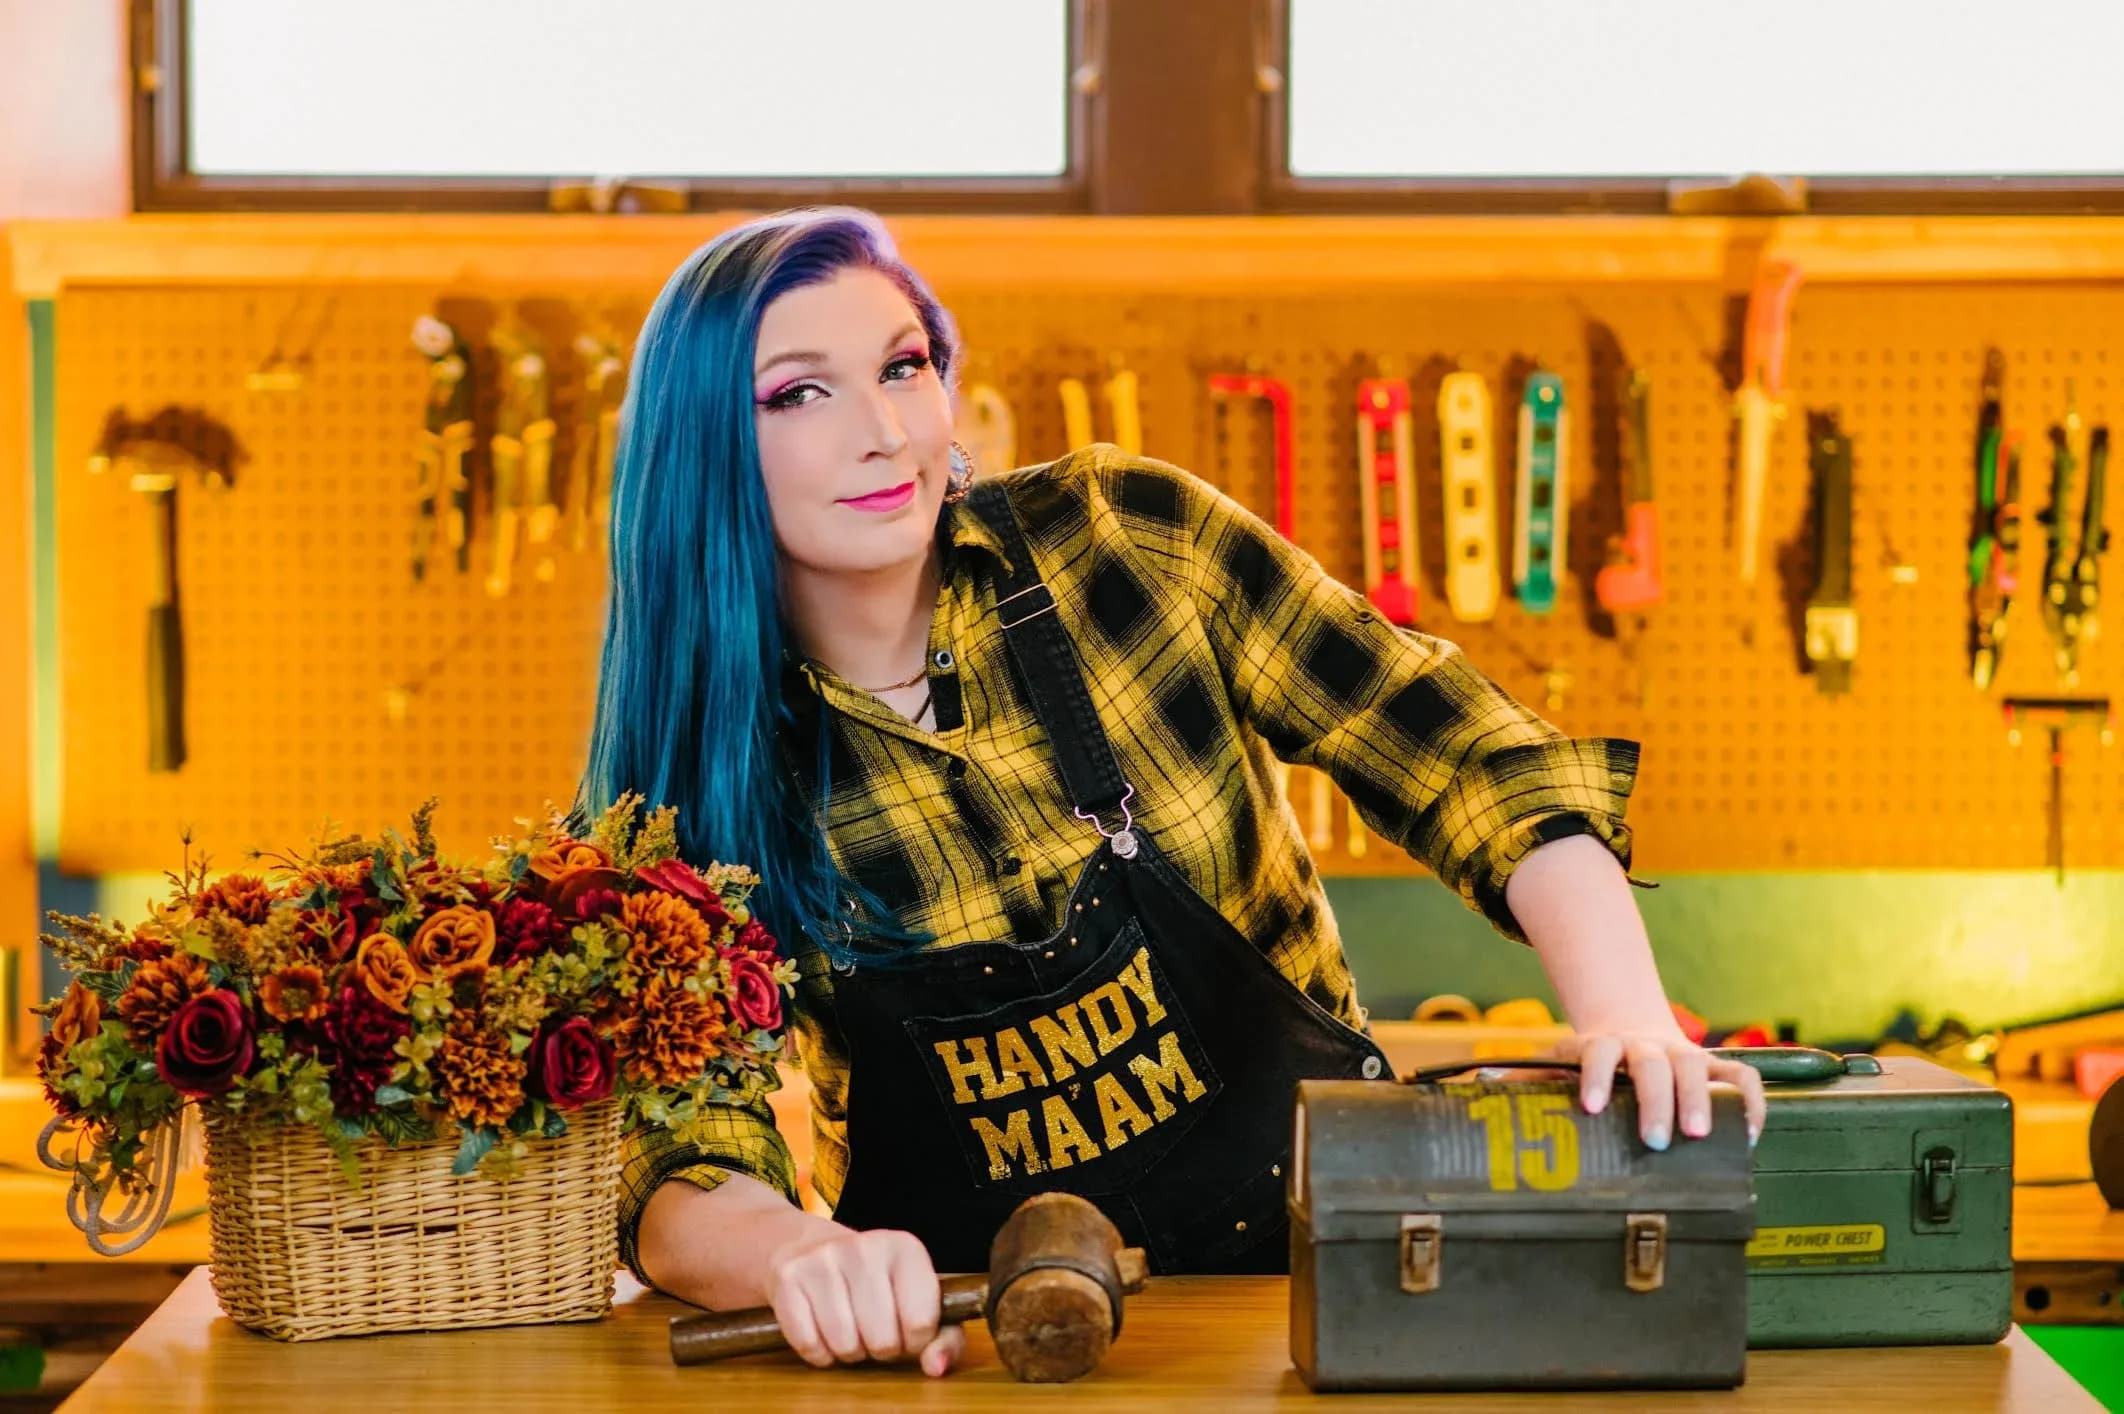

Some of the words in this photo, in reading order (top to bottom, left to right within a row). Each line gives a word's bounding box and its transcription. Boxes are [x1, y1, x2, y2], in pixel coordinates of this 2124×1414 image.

[933, 946, 1168, 1105] HANDY
[1468, 1093, 1580, 1192] 15
[1785, 1233, 1831, 1248] POWER
[1836, 1231, 1873, 1246] CHEST
